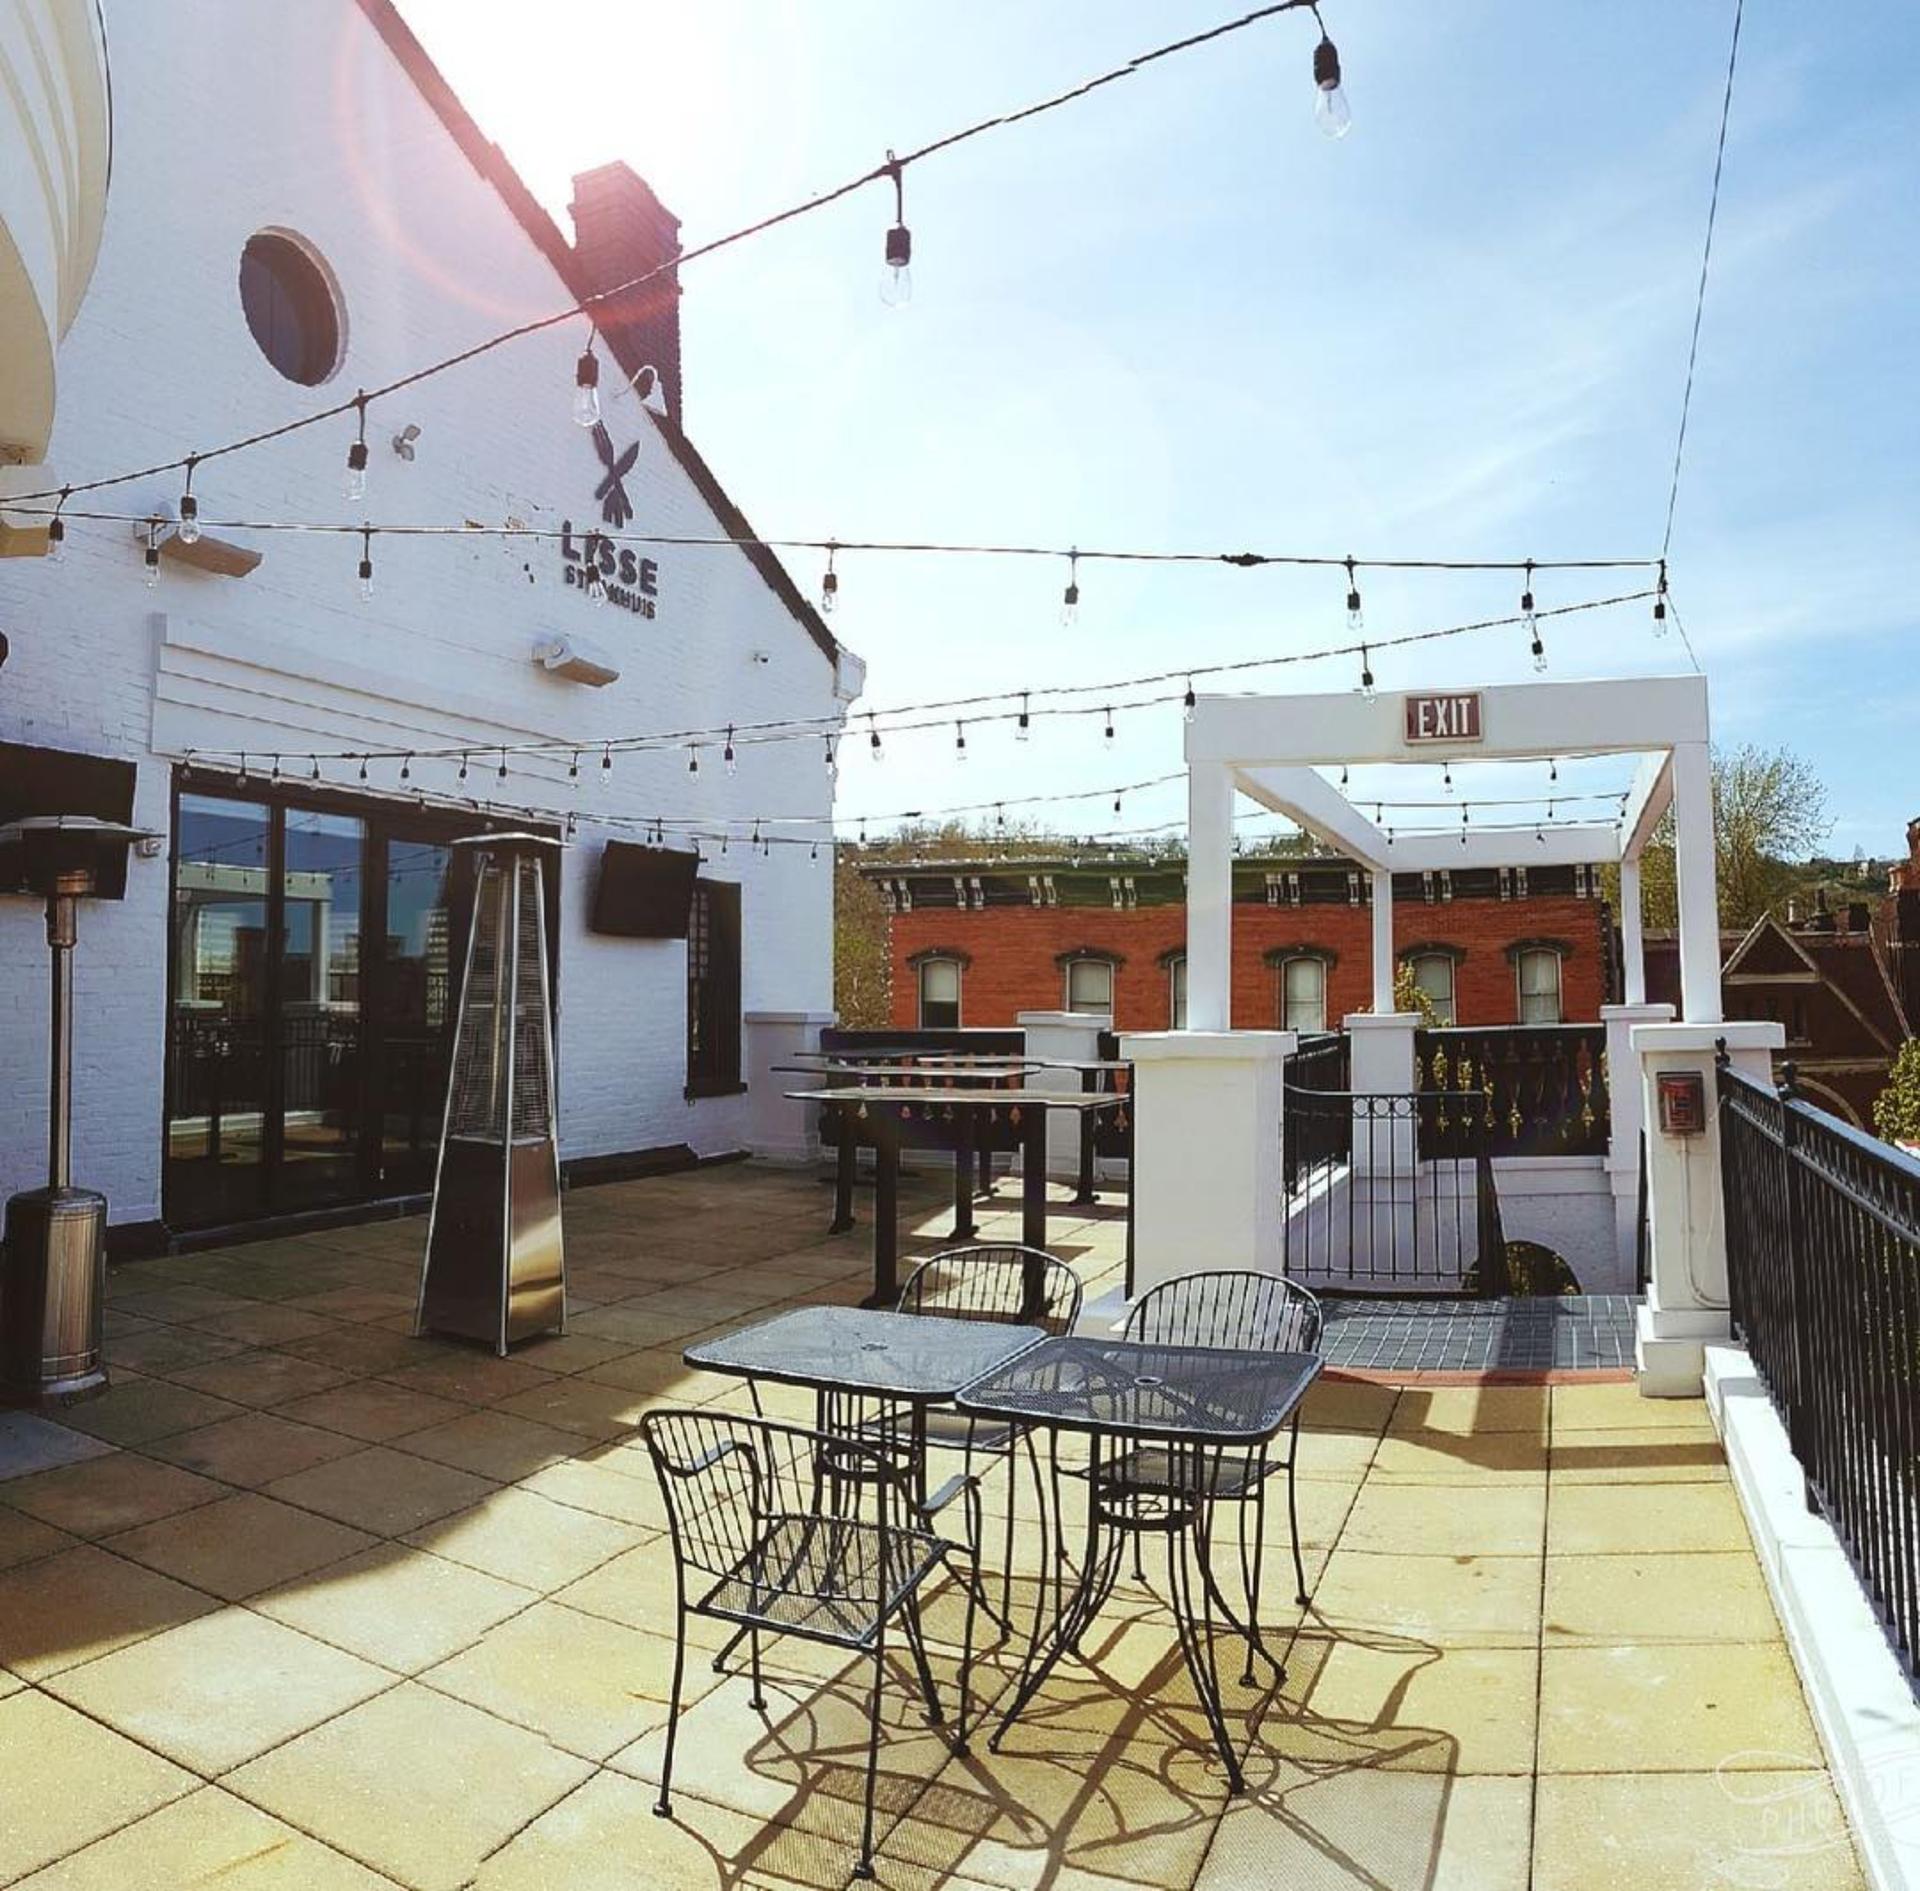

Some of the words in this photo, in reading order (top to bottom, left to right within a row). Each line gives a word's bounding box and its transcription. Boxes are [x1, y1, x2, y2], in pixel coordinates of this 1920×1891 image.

[562, 520, 658, 596] LISSE
[565, 565, 655, 619] STKHUIS
[1418, 698, 1471, 737] EXIT
